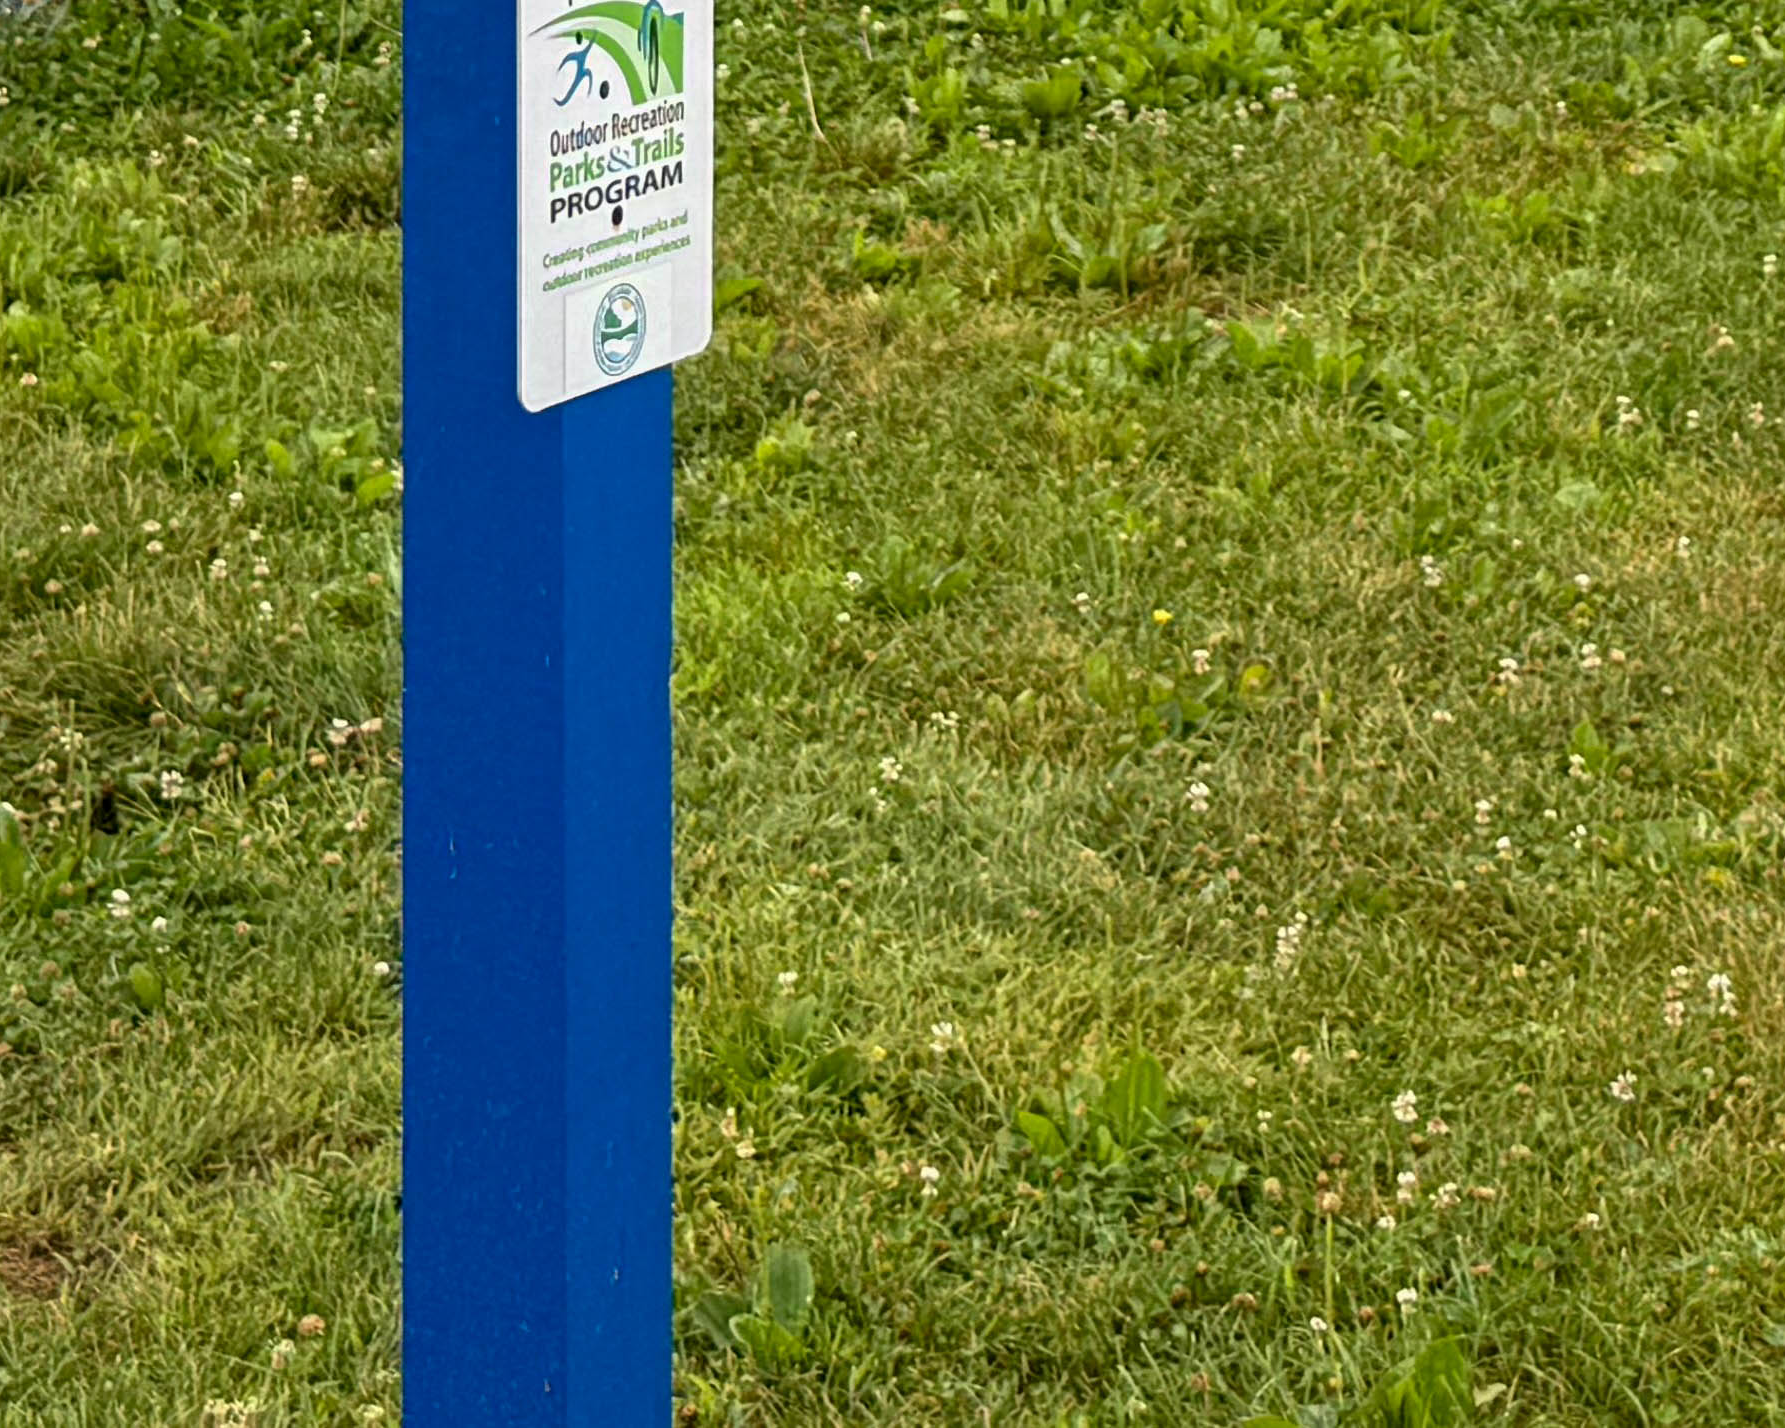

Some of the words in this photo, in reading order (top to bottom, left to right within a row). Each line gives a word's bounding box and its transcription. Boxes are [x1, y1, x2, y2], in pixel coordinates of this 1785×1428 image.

[550, 120, 608, 157] Outdoor
[611, 99, 685, 140] Recreation
[550, 160, 683, 224] PROGRAM
